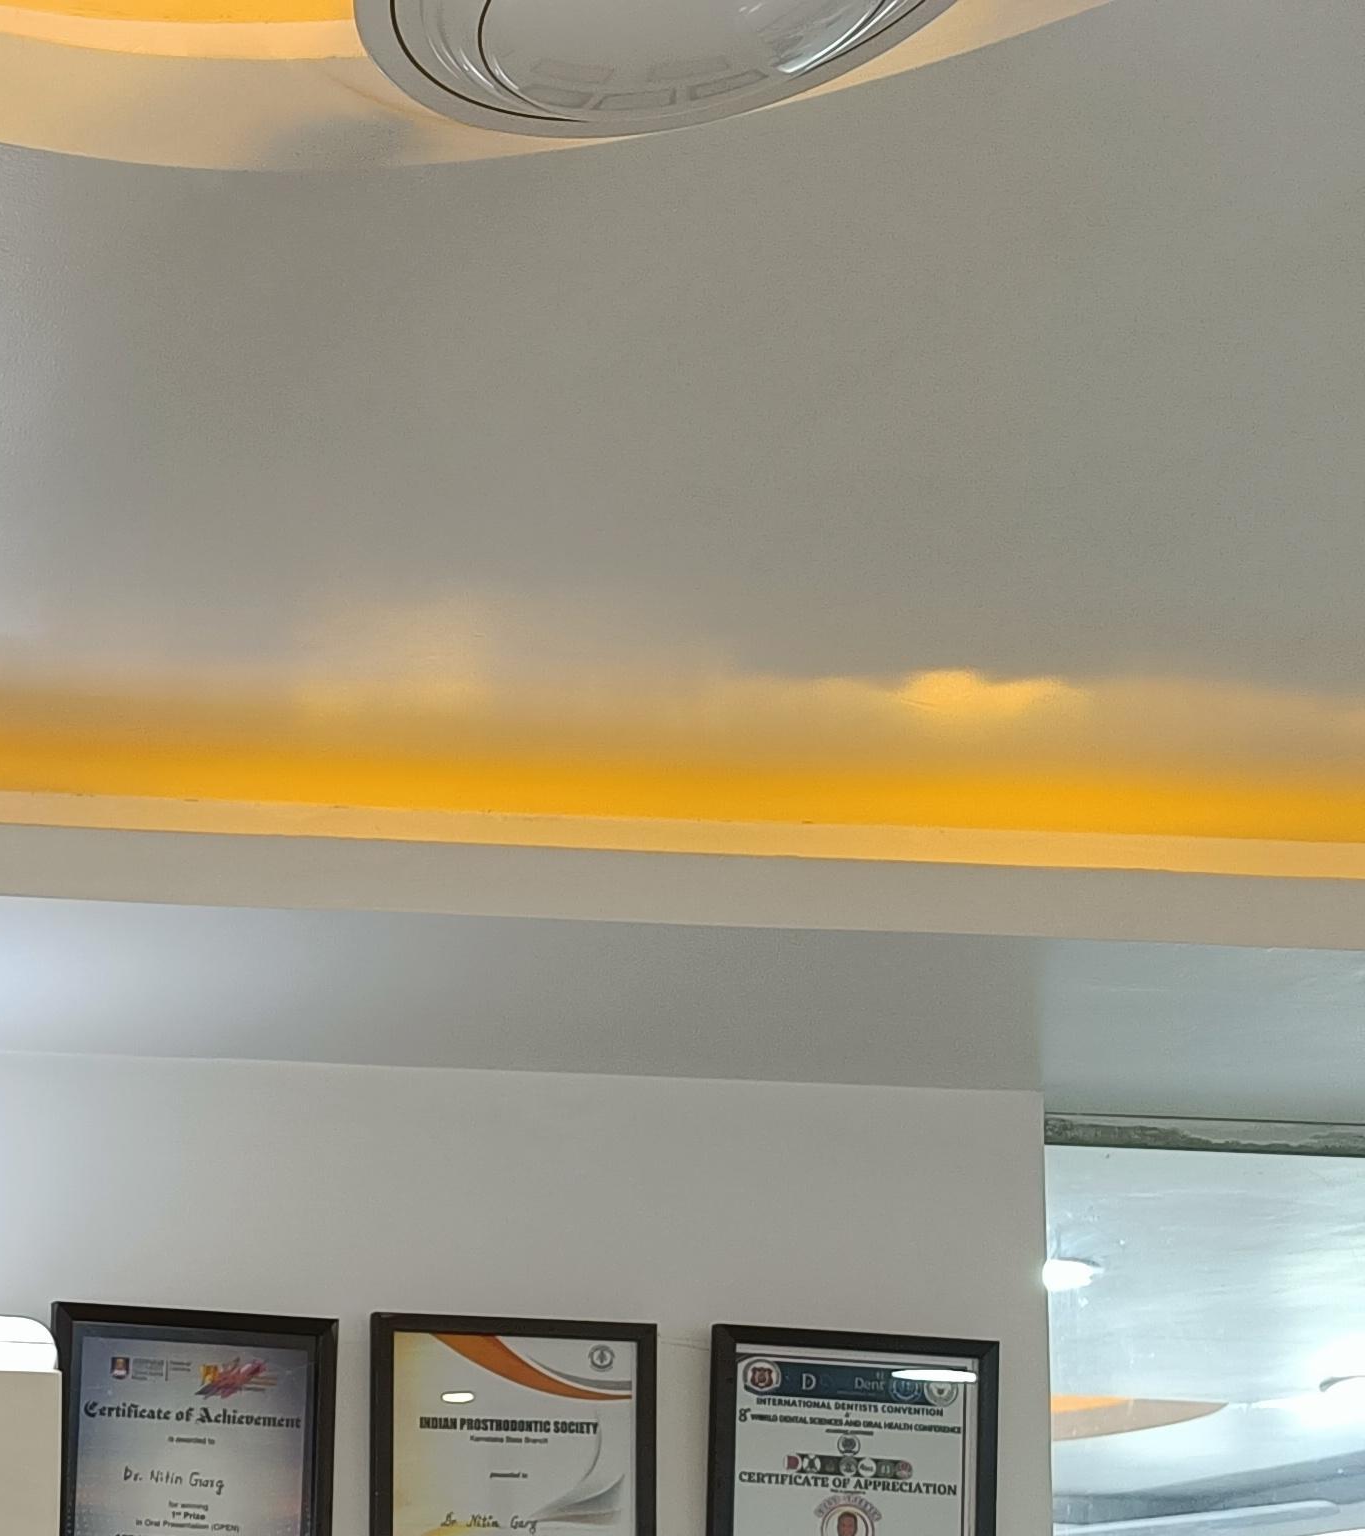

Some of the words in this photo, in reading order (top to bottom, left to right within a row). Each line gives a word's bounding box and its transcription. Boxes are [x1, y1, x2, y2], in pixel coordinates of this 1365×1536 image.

[84, 1402, 171, 1421] Certificate
[175, 1407, 194, 1422] of
[196, 1407, 301, 1429] Achievement
[756, 1397, 831, 1410] INTERNATIONAL
[835, 1402, 878, 1413] DENTISTS
[881, 1405, 943, 1417] CONVENTION
[419, 1417, 457, 1430] INDIAN
[460, 1417, 551, 1433] PROSTHODONTIC
[554, 1421, 598, 1435] SOCIETY
[780, 1415, 808, 1424] DENTAL
[810, 1417, 843, 1425] SCIENCES
[845, 1418, 861, 1427] AND
[863, 1420, 882, 1429] ORAL
[884, 1422, 912, 1431] HEALTH
[914, 1424, 962, 1434] CONFERENCE
[150, 1470, 183, 1485] Nitin
[739, 1471, 829, 1488] CERTIFICATE
[832, 1477, 852, 1489] OF
[854, 1478, 957, 1495] APPRECIATION
[184, 1512, 205, 1520] Prize
